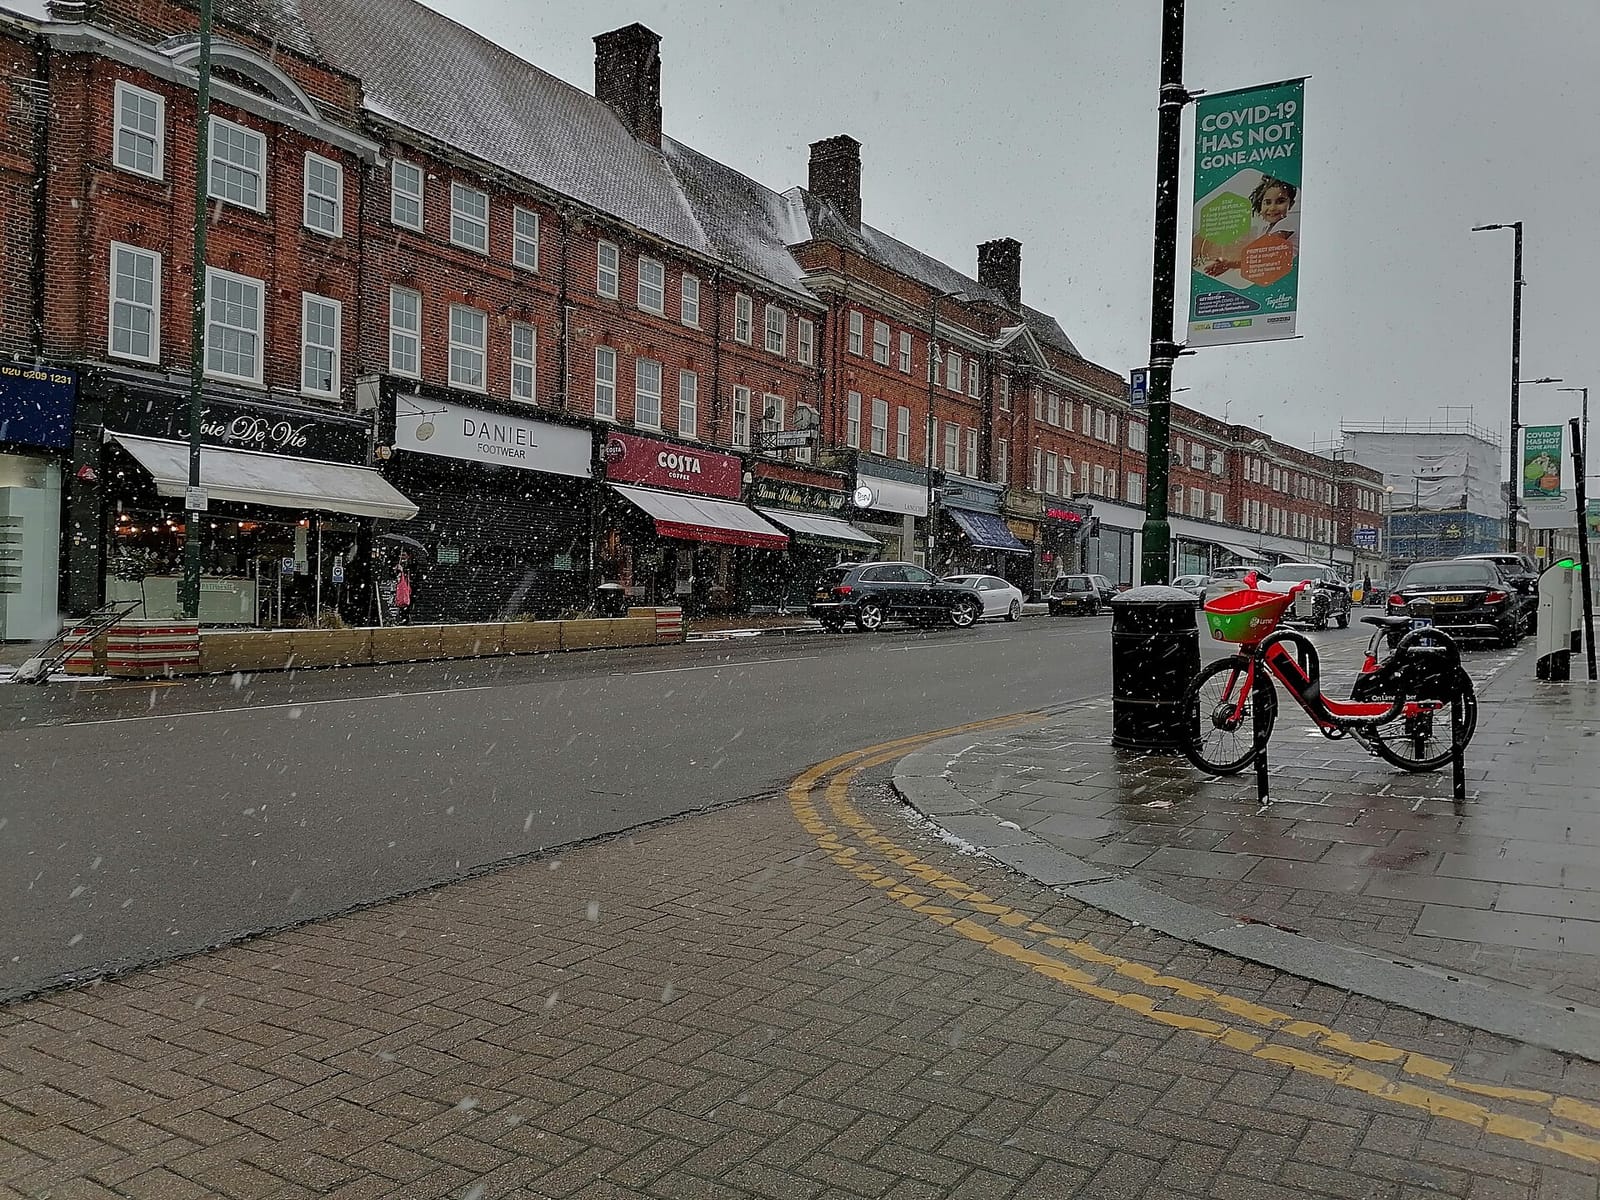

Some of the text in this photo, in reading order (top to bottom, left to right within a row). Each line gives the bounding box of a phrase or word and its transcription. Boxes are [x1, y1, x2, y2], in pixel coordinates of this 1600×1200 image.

[1201, 100, 1297, 133] COVID-19
[1202, 122, 1295, 153] HAS NOT
[1200, 143, 1295, 170] GONE AWAY
[49, 373, 72, 385] 1231
[1133, 374, 1144, 388] P
[229, 416, 268, 441] De
[271, 421, 316, 448] Vie
[464, 418, 539, 448] DANIEL
[1526, 431, 1561, 439] COVID-19
[477, 443, 527, 459] FOOTWEAR
[657, 451, 701, 474] COSTA
[668, 471, 690, 481] COFFEE
